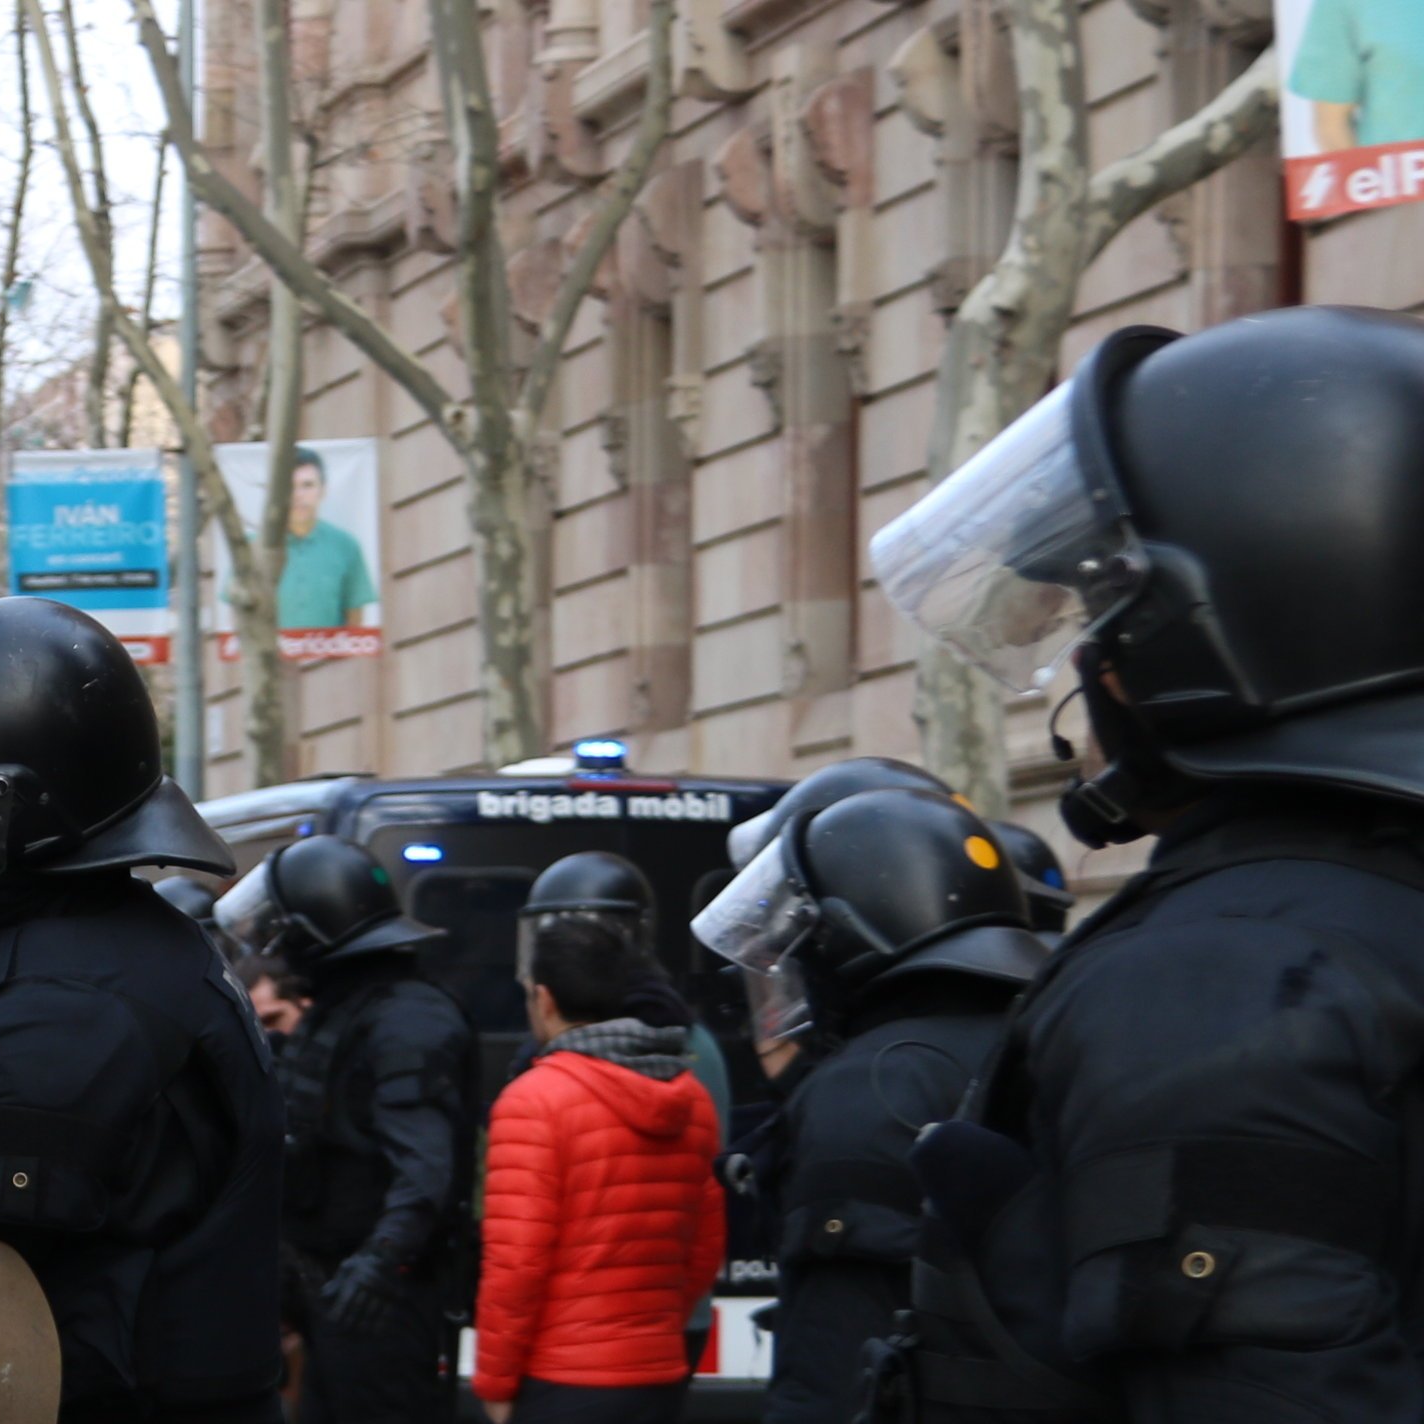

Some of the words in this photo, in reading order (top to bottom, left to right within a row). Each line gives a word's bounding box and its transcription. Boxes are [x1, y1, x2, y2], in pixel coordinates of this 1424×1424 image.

[54, 499, 121, 527] IVÁN
[11, 521, 161, 549] FERREIRO
[476, 790, 620, 824] brigada
